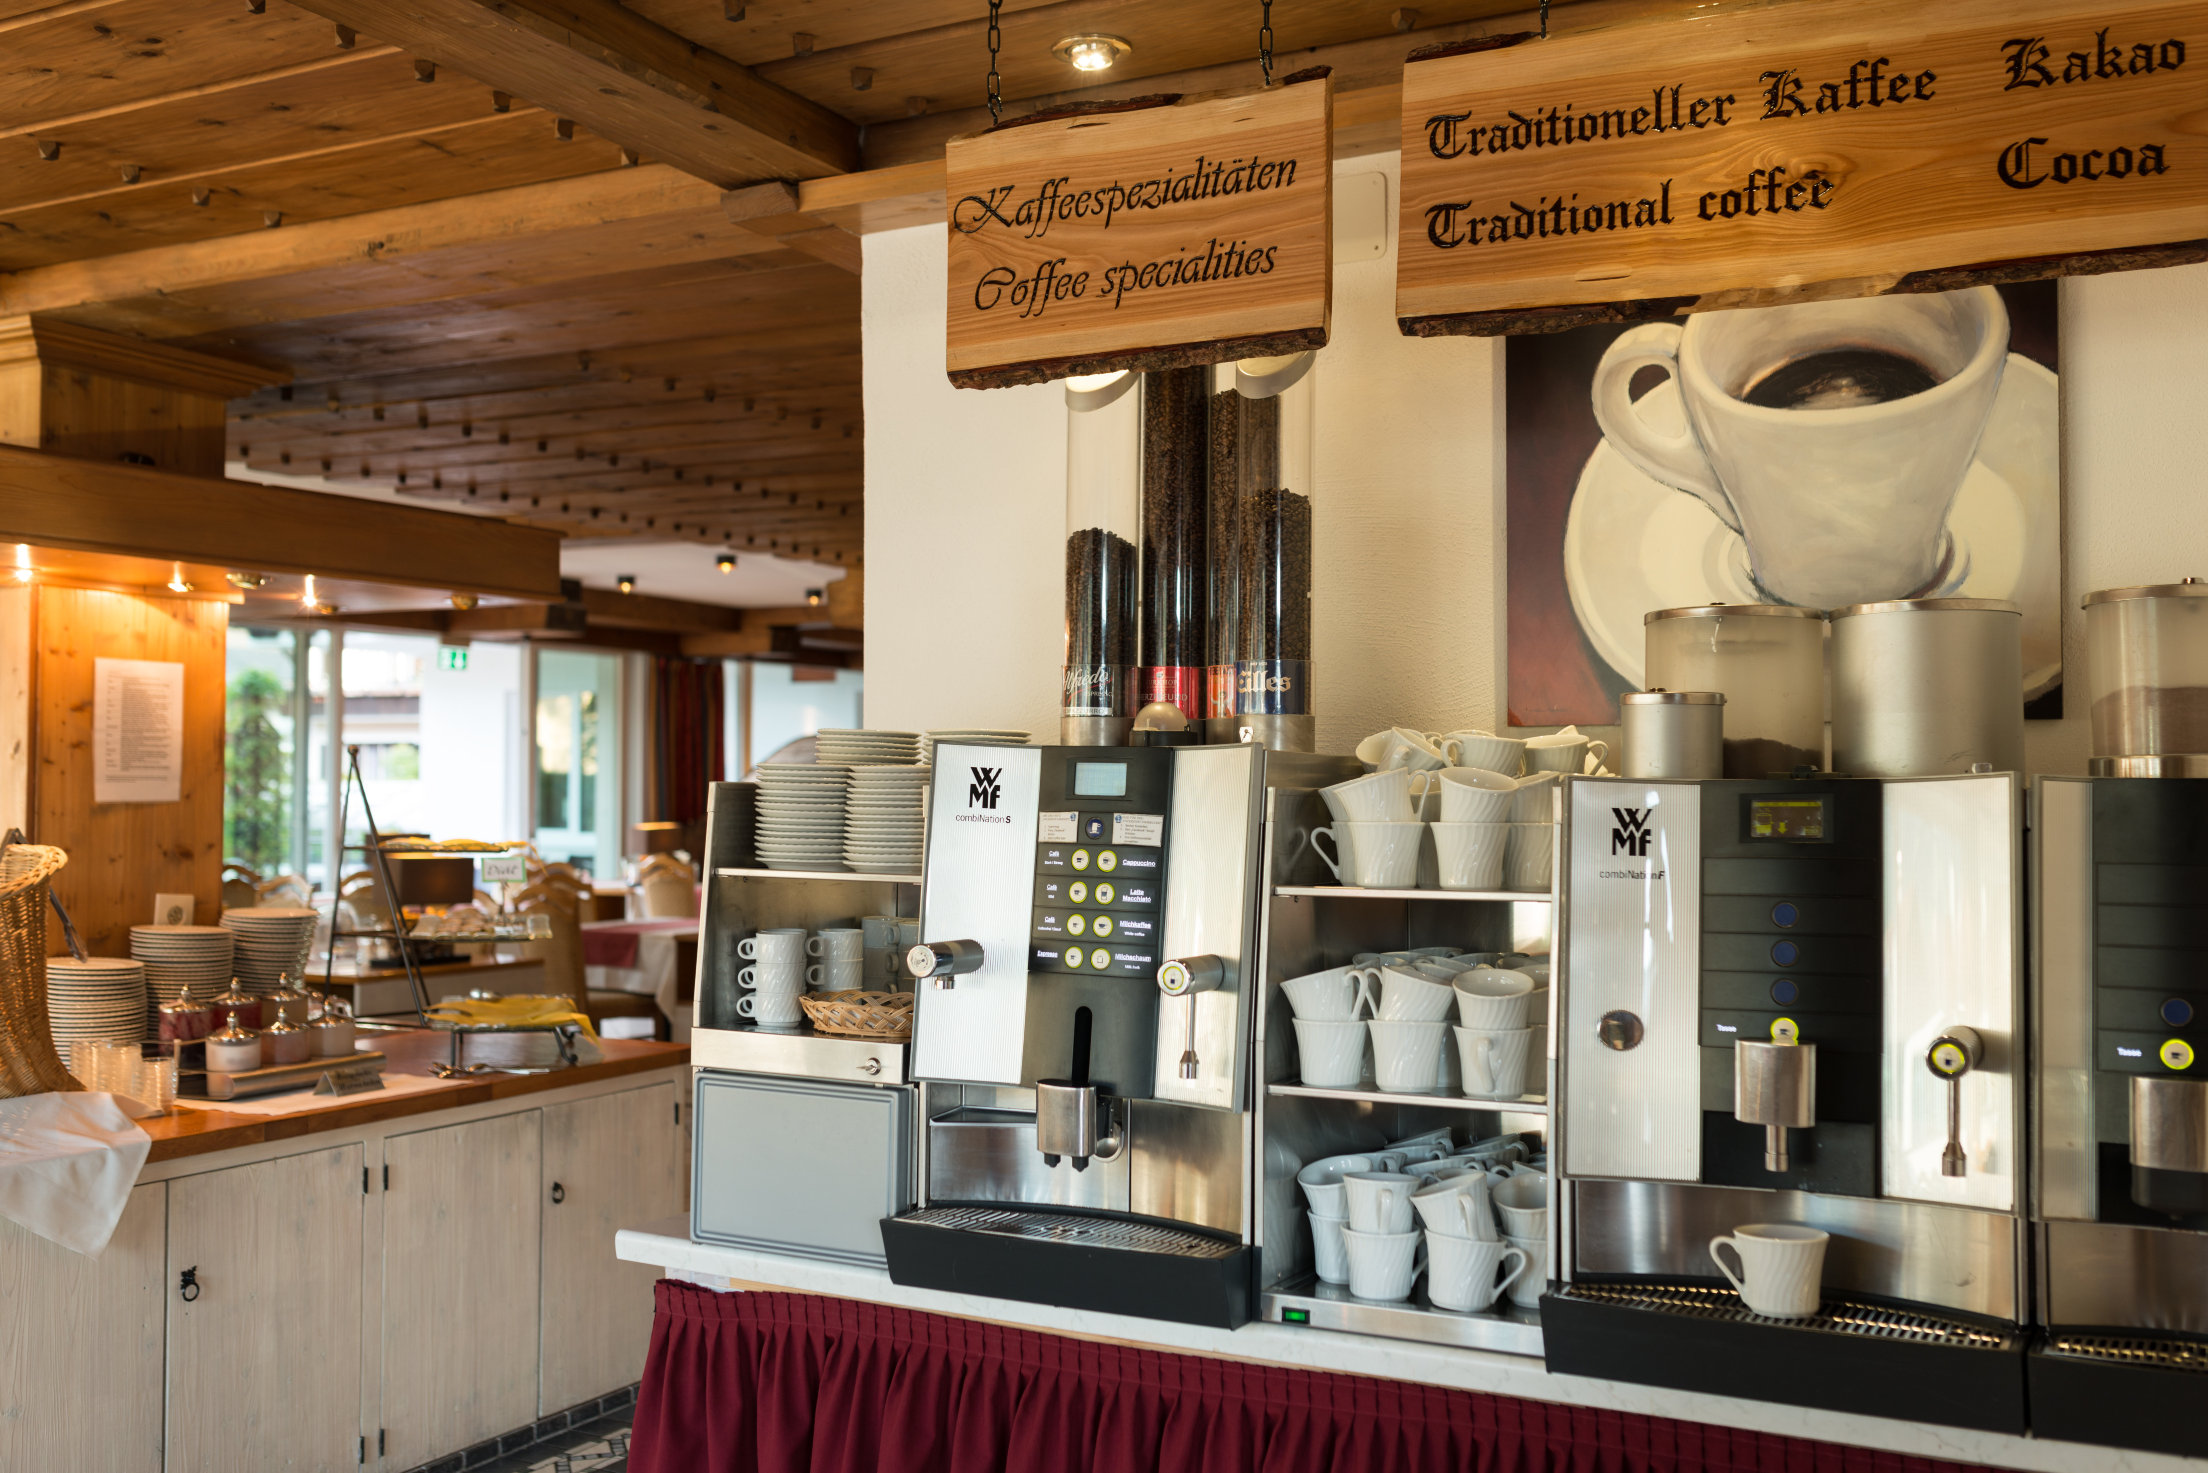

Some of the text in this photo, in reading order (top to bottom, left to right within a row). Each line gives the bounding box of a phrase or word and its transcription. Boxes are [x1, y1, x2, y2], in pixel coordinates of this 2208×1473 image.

[2000, 26, 2186, 92] Kakao
[1425, 57, 1937, 160] Traditioneller Kaffee
[954, 156, 1297, 238] Kaffeespezialitäten
[1997, 137, 2171, 189] Cocoa
[1425, 166, 1836, 249] Traditional coffee
[974, 238, 1278, 318] Coffee specialities
[969, 767, 1002, 809] WMF
[1612, 808, 1652, 856] WMF
